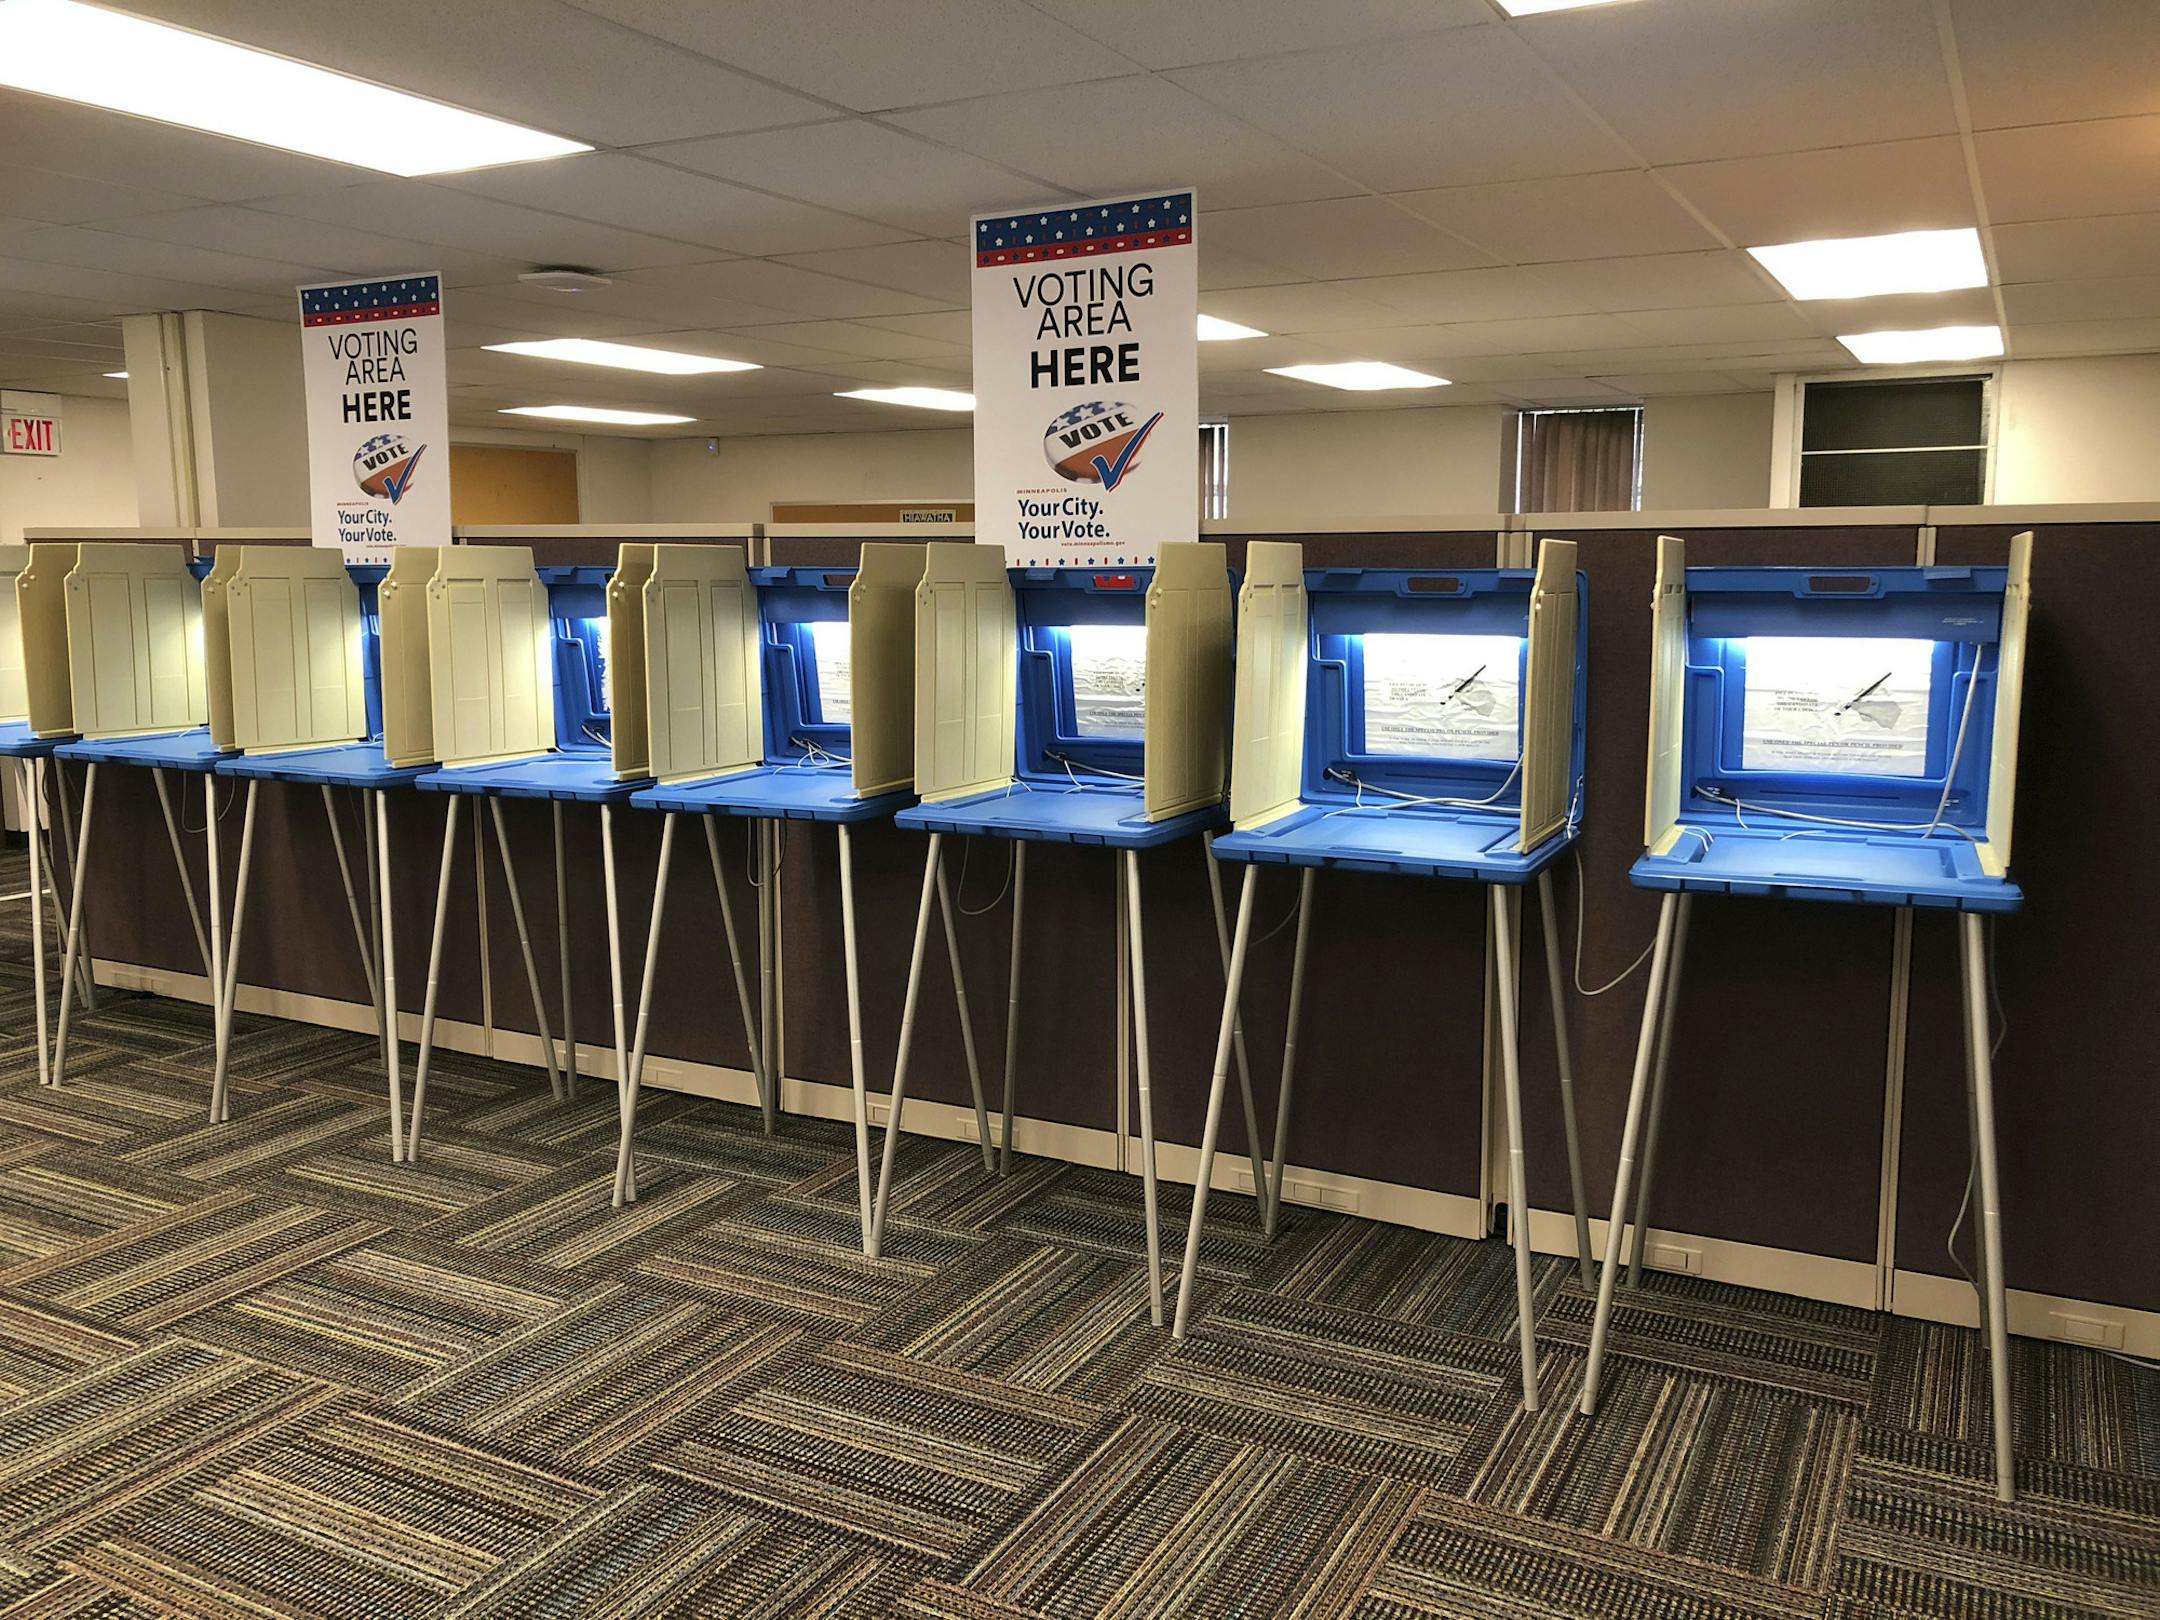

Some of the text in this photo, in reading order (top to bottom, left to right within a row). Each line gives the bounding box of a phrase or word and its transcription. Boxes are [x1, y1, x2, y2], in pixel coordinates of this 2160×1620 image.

[1013, 263, 1153, 308] VOTING
[1036, 300, 1132, 340] AREA
[328, 328, 418, 360] VOTING
[345, 356, 405, 385] AREA
[1031, 342, 1140, 388] HERE
[342, 389, 412, 423] HERE
[11, 418, 53, 451] EXIT
[1059, 412, 1134, 449] VOTE
[362, 443, 409, 471] VOTE
[903, 512, 952, 523] HIAWATHA
